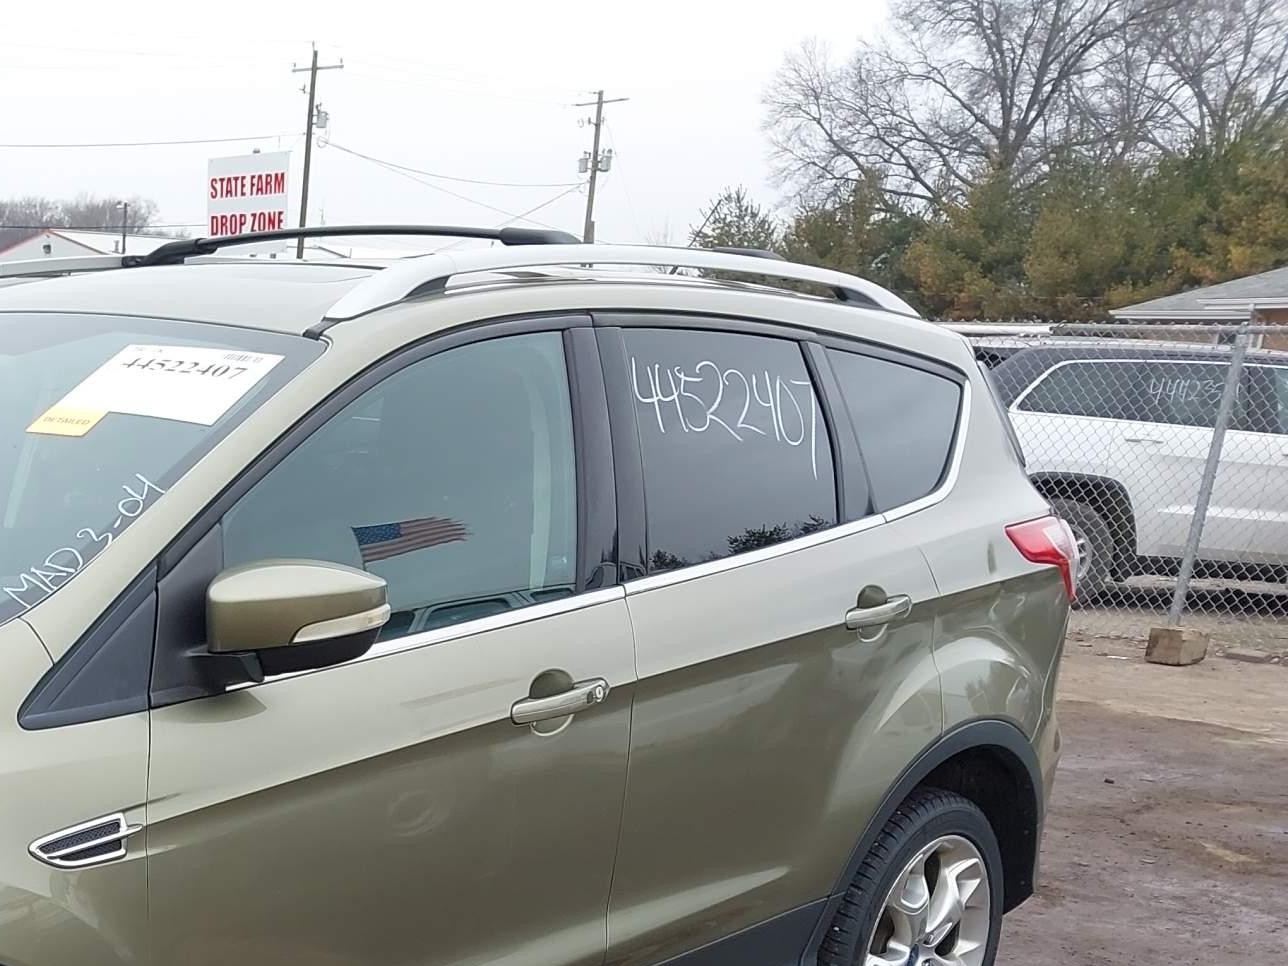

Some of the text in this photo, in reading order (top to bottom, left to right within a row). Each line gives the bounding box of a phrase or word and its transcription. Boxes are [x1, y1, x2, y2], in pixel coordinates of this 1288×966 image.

[210, 172, 285, 199] STATE FARM
[210, 211, 284, 236] DROP ZONE
[122, 356, 248, 380] 44522407
[631, 356, 818, 480] 44522407
[3, 473, 166, 609] MAD 3-04
